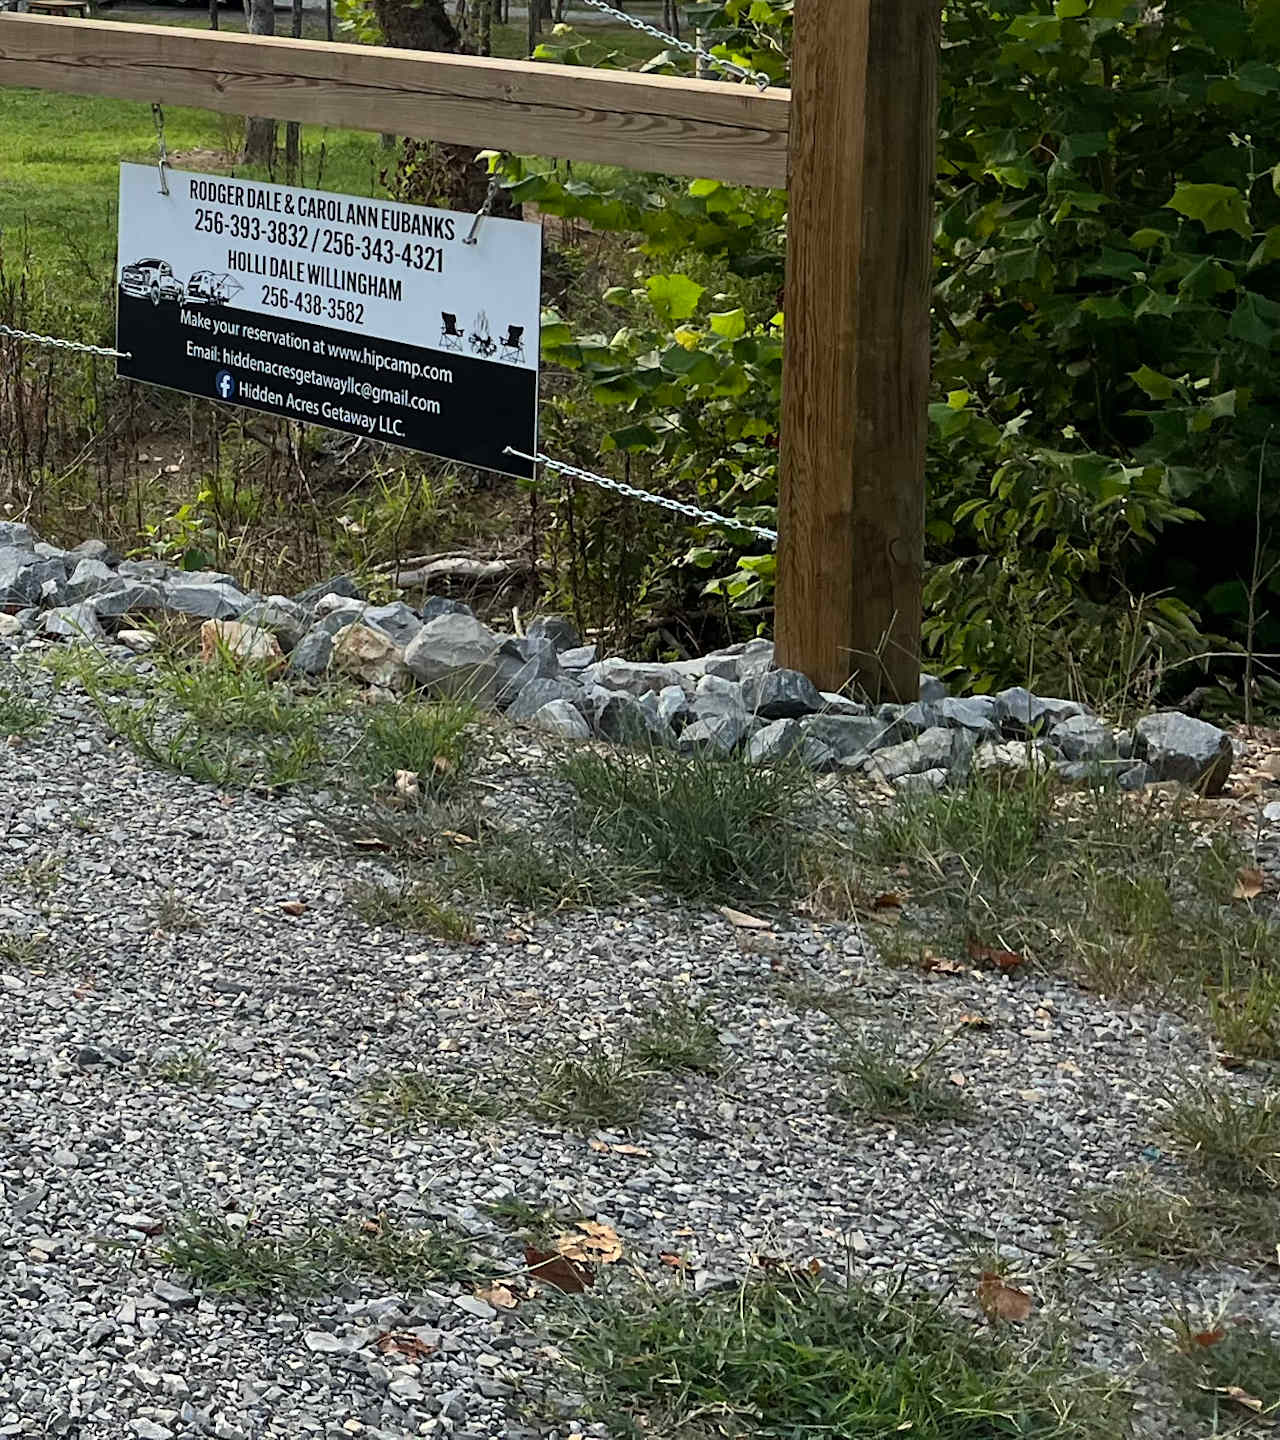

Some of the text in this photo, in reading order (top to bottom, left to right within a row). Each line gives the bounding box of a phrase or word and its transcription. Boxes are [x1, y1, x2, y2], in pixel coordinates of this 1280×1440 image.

[189, 179, 245, 207] RODGER
[247, 188, 282, 213] DALE
[284, 193, 295, 215] &
[381, 208, 456, 241] EUBANKS
[194, 208, 309, 249] 256-393-3832
[322, 229, 444, 273] 256-343-4321
[227, 249, 403, 302] HOLLI DALE WILLINGHAM
[261, 284, 365, 325] 256-438-3582
[180, 309, 454, 384] Make your reservation at www.hipcamp.com
[186, 341, 441, 415] Email: hiddenacresgetawayllc@gmail.com
[239, 381, 284, 407] Hidden
[286, 393, 320, 416] Acres
[321, 402, 377, 434] Getaway
[379, 415, 407, 438] LLC.
